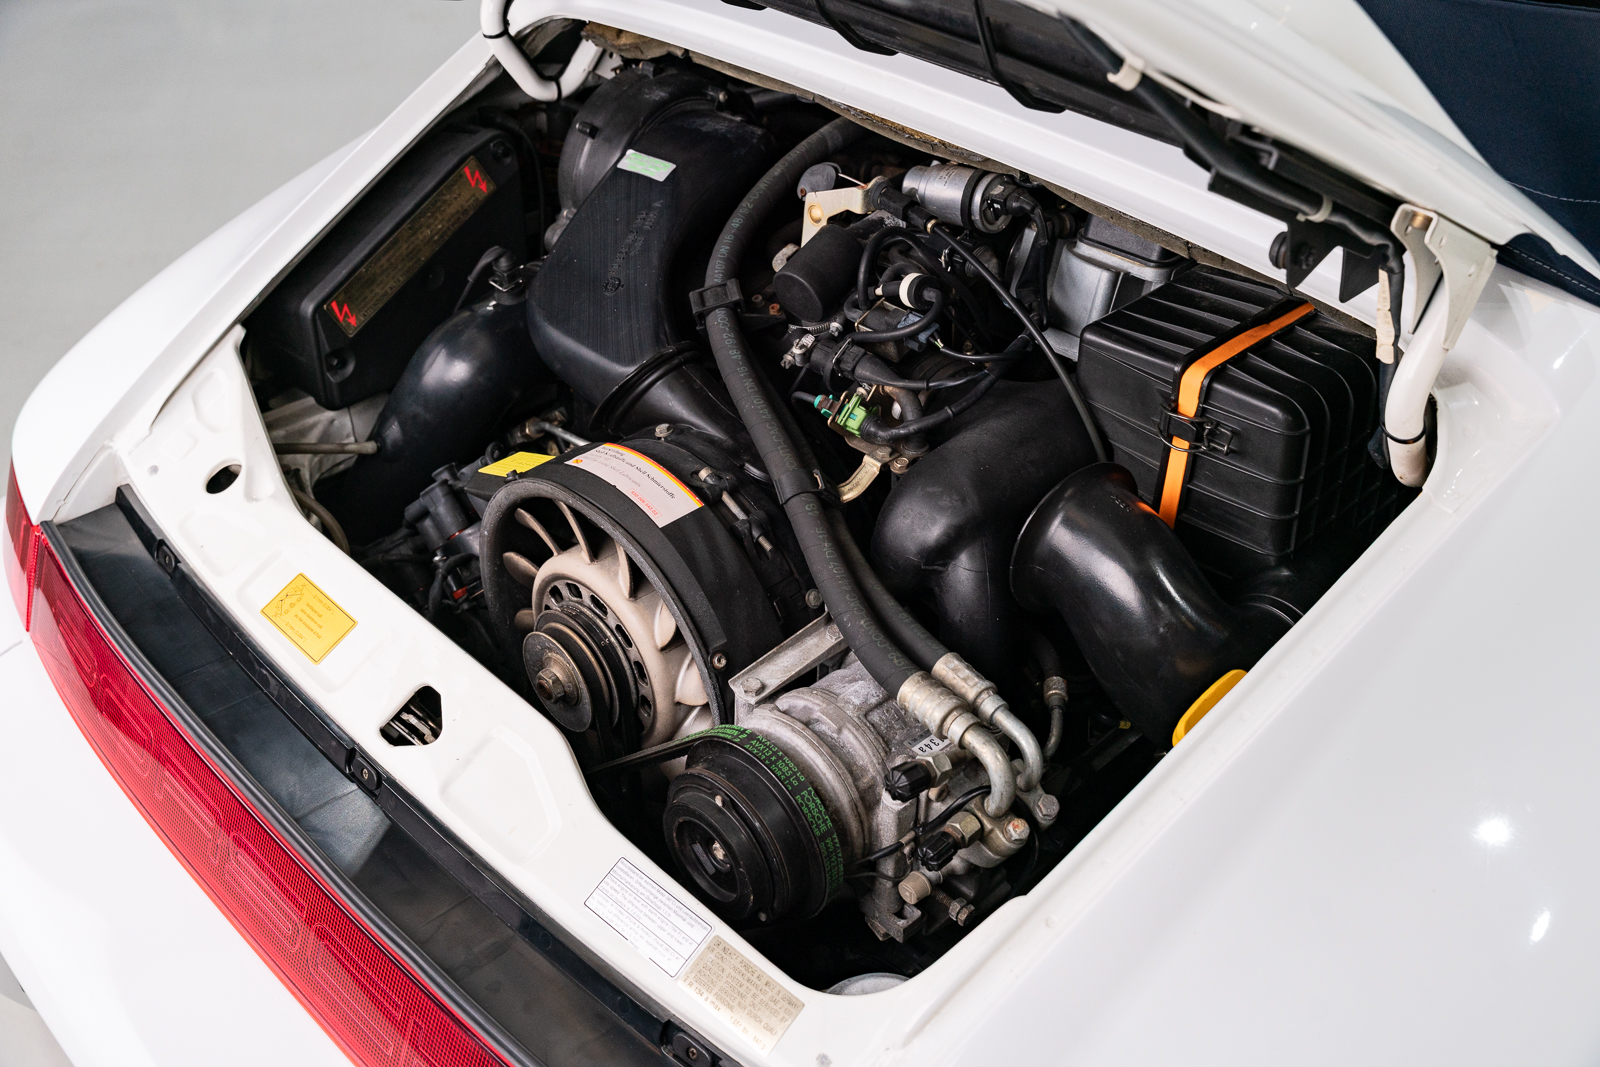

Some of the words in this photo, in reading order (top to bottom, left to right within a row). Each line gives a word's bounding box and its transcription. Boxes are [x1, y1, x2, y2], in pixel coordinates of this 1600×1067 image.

[717, 243, 730, 259] DN
[741, 376, 758, 395] DN
[748, 736, 773, 758] AVX13
[775, 757, 792, 779] 1085
[800, 787, 828, 835] PORSCHE
[691, 974, 714, 994] FIZIERTES
[712, 991, 736, 1012] PERSONAL
[693, 986, 704, 997] 134
[701, 962, 724, 982] QUALIFIED
[722, 979, 749, 1002] PERSONNEL
[747, 999, 761, 1012] ONLY
[717, 985, 737, 1003] SERVICE
[735, 999, 747, 1012] NUR
[746, 1008, 763, 1025] DURCH
[725, 971, 744, 989] SYSTEM
[757, 997, 781, 1018] SERVICED
[779, 992, 800, 1011] GERMANY
